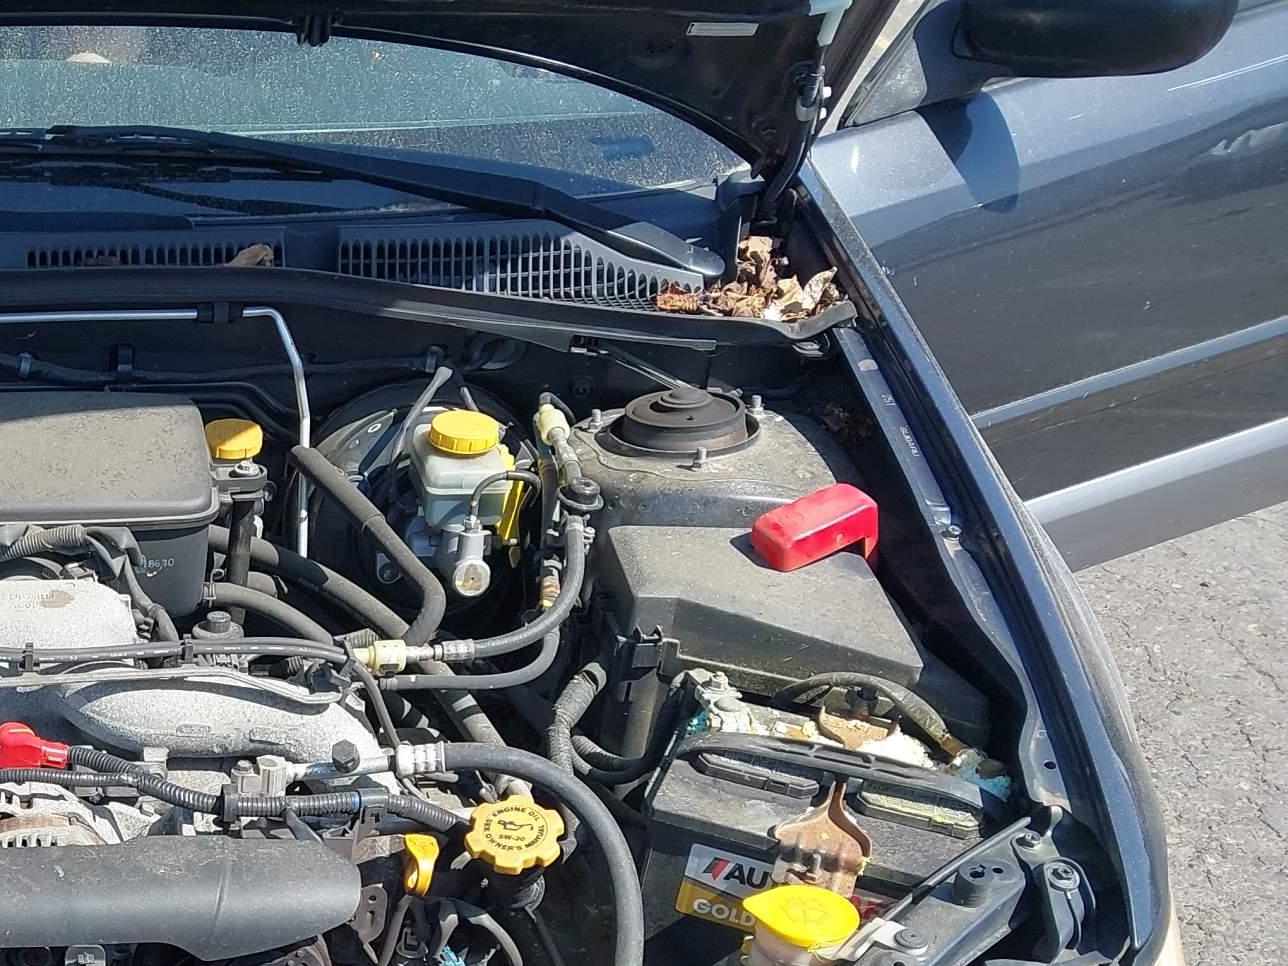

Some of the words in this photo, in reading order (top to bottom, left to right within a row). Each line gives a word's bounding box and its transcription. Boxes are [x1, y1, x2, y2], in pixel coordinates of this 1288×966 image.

[492, 806, 527, 818] ENGINE
[528, 811, 541, 822] OIL
[483, 819, 493, 832] SEE
[485, 834, 524, 852] OWNER'S
[524, 824, 545, 849] MANUAL
[691, 897, 756, 927] GOLD
